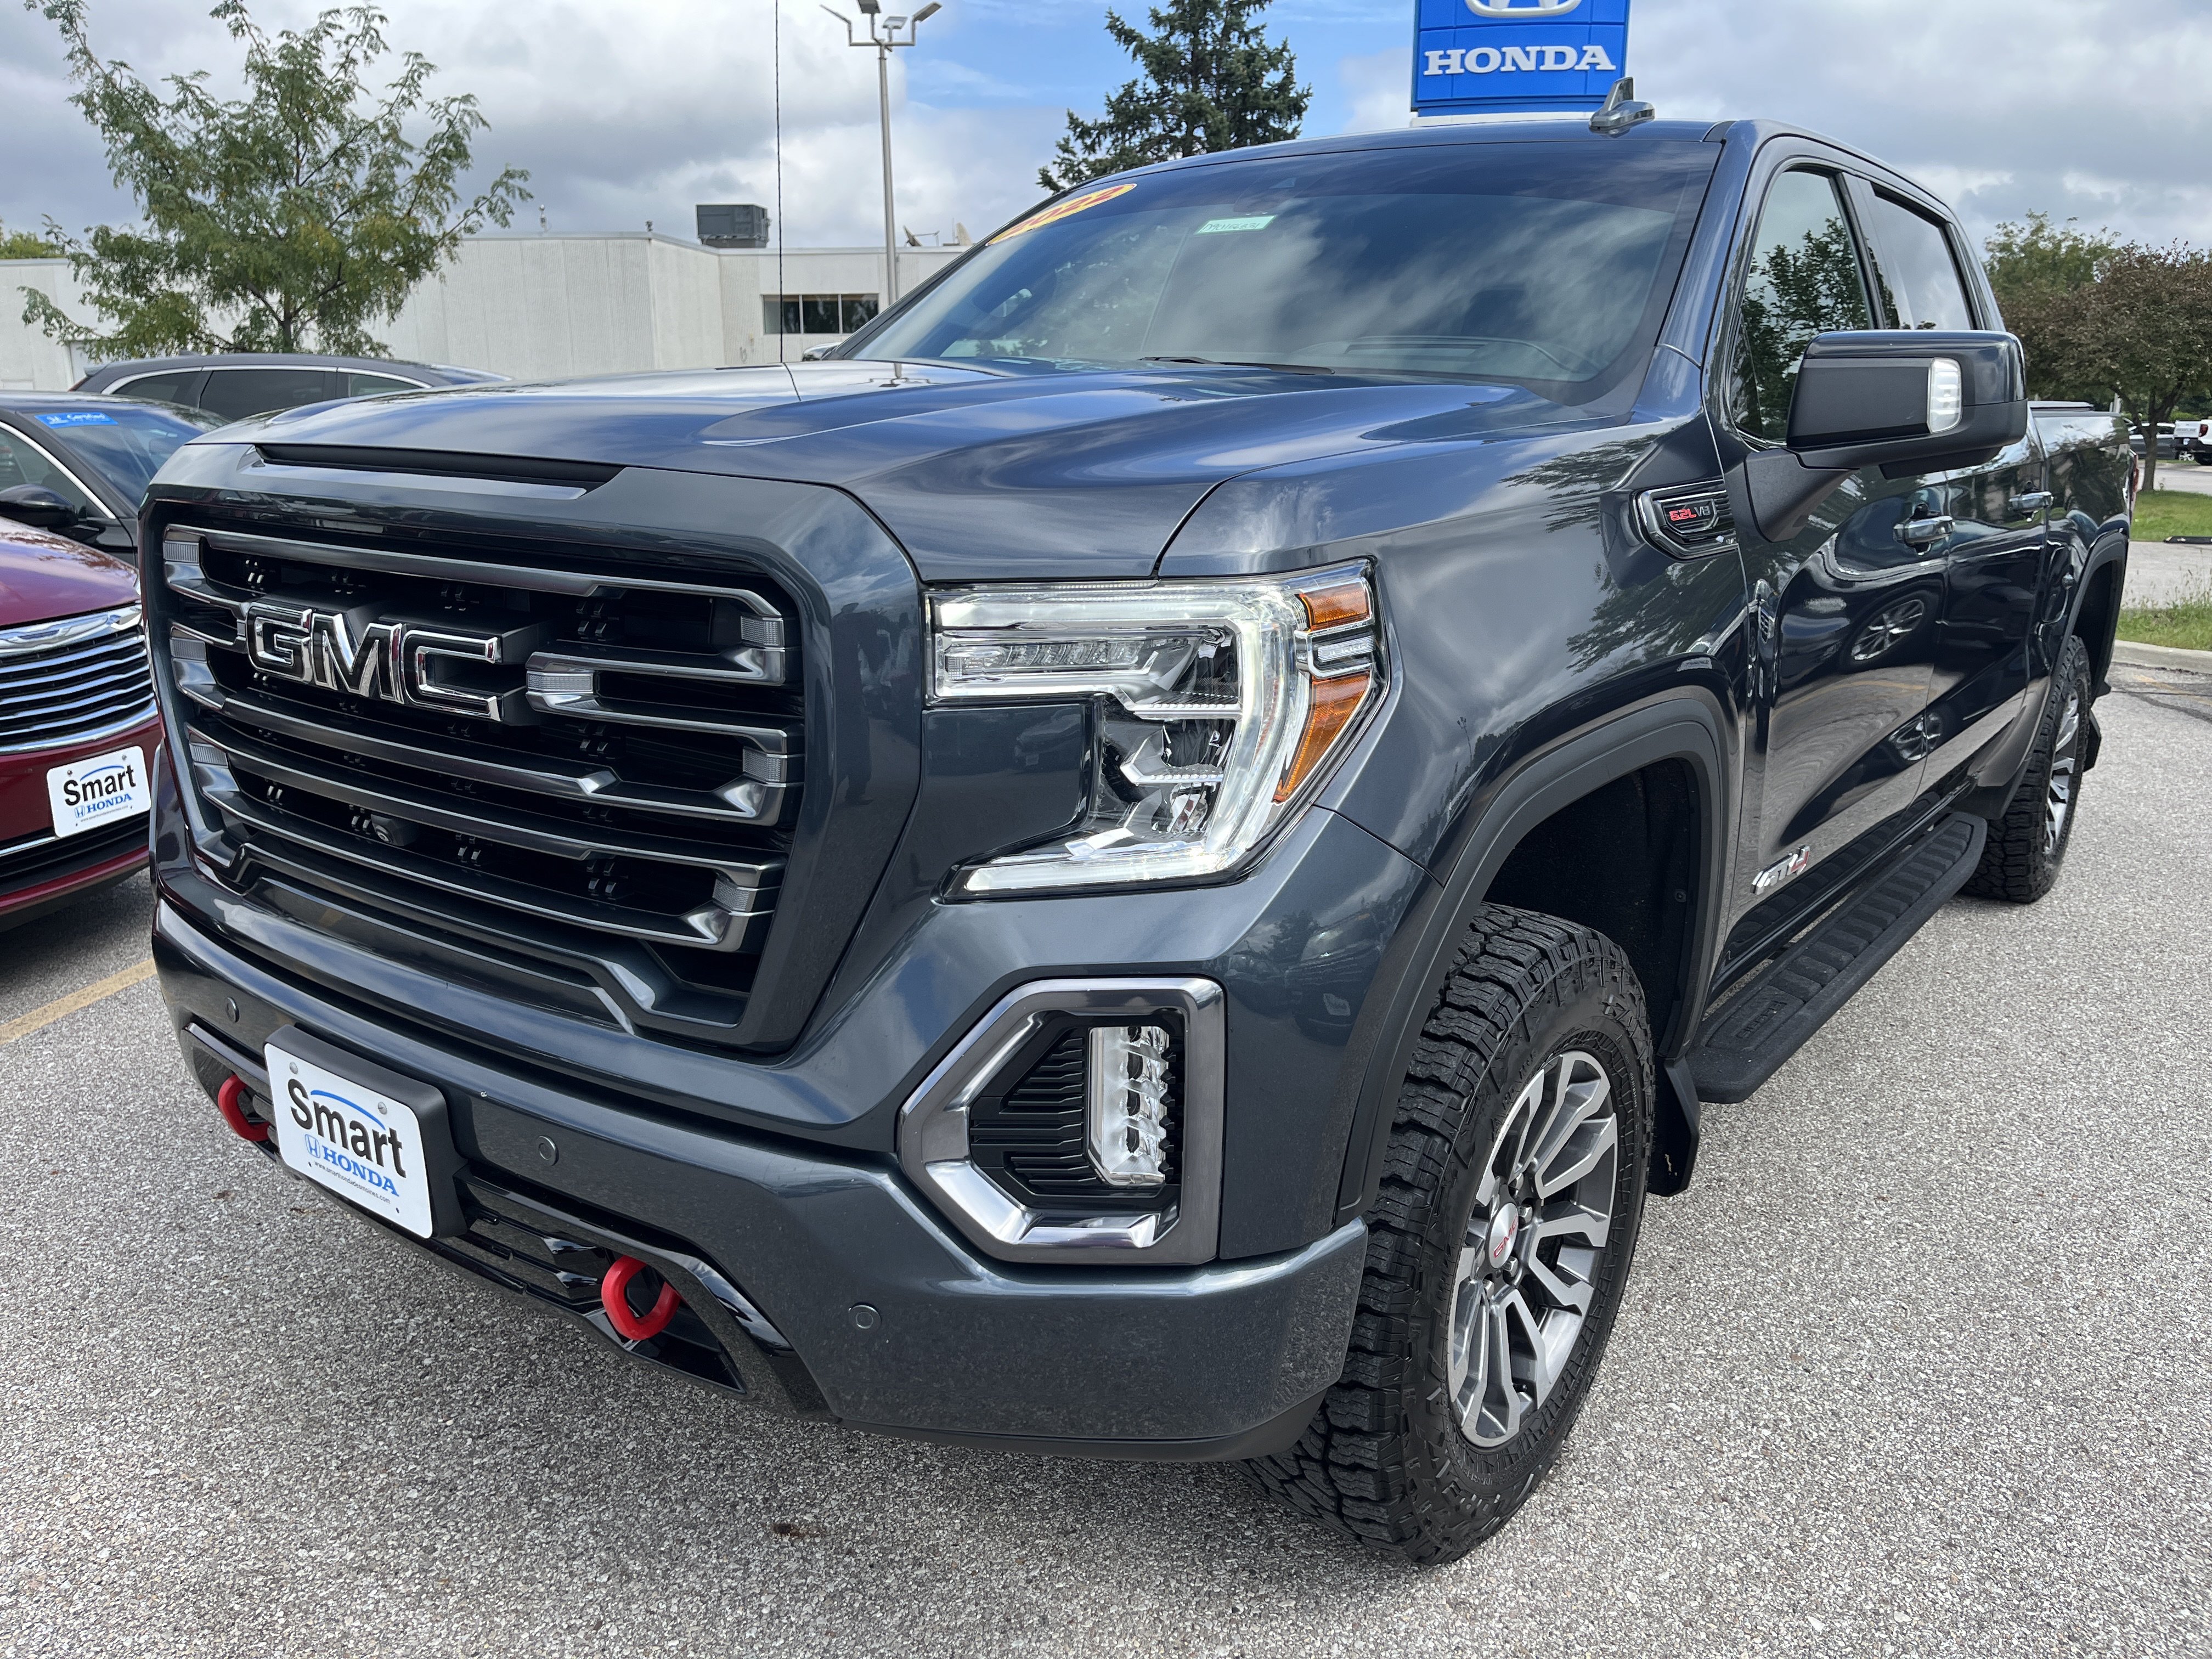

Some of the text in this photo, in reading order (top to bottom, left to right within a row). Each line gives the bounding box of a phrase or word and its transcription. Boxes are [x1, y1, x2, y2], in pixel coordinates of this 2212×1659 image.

[1424, 46, 1616, 75] HONDA
[1000, 186, 1125, 238] 2022
[246, 602, 505, 723] GMC
[64, 765, 136, 806] Smart
[87, 793, 132, 813] HONDA
[1750, 845, 1810, 895] AT4
[287, 1078, 407, 1178] Smart
[321, 1145, 400, 1197] HONDA
[1493, 1215, 1519, 1258] GMC
